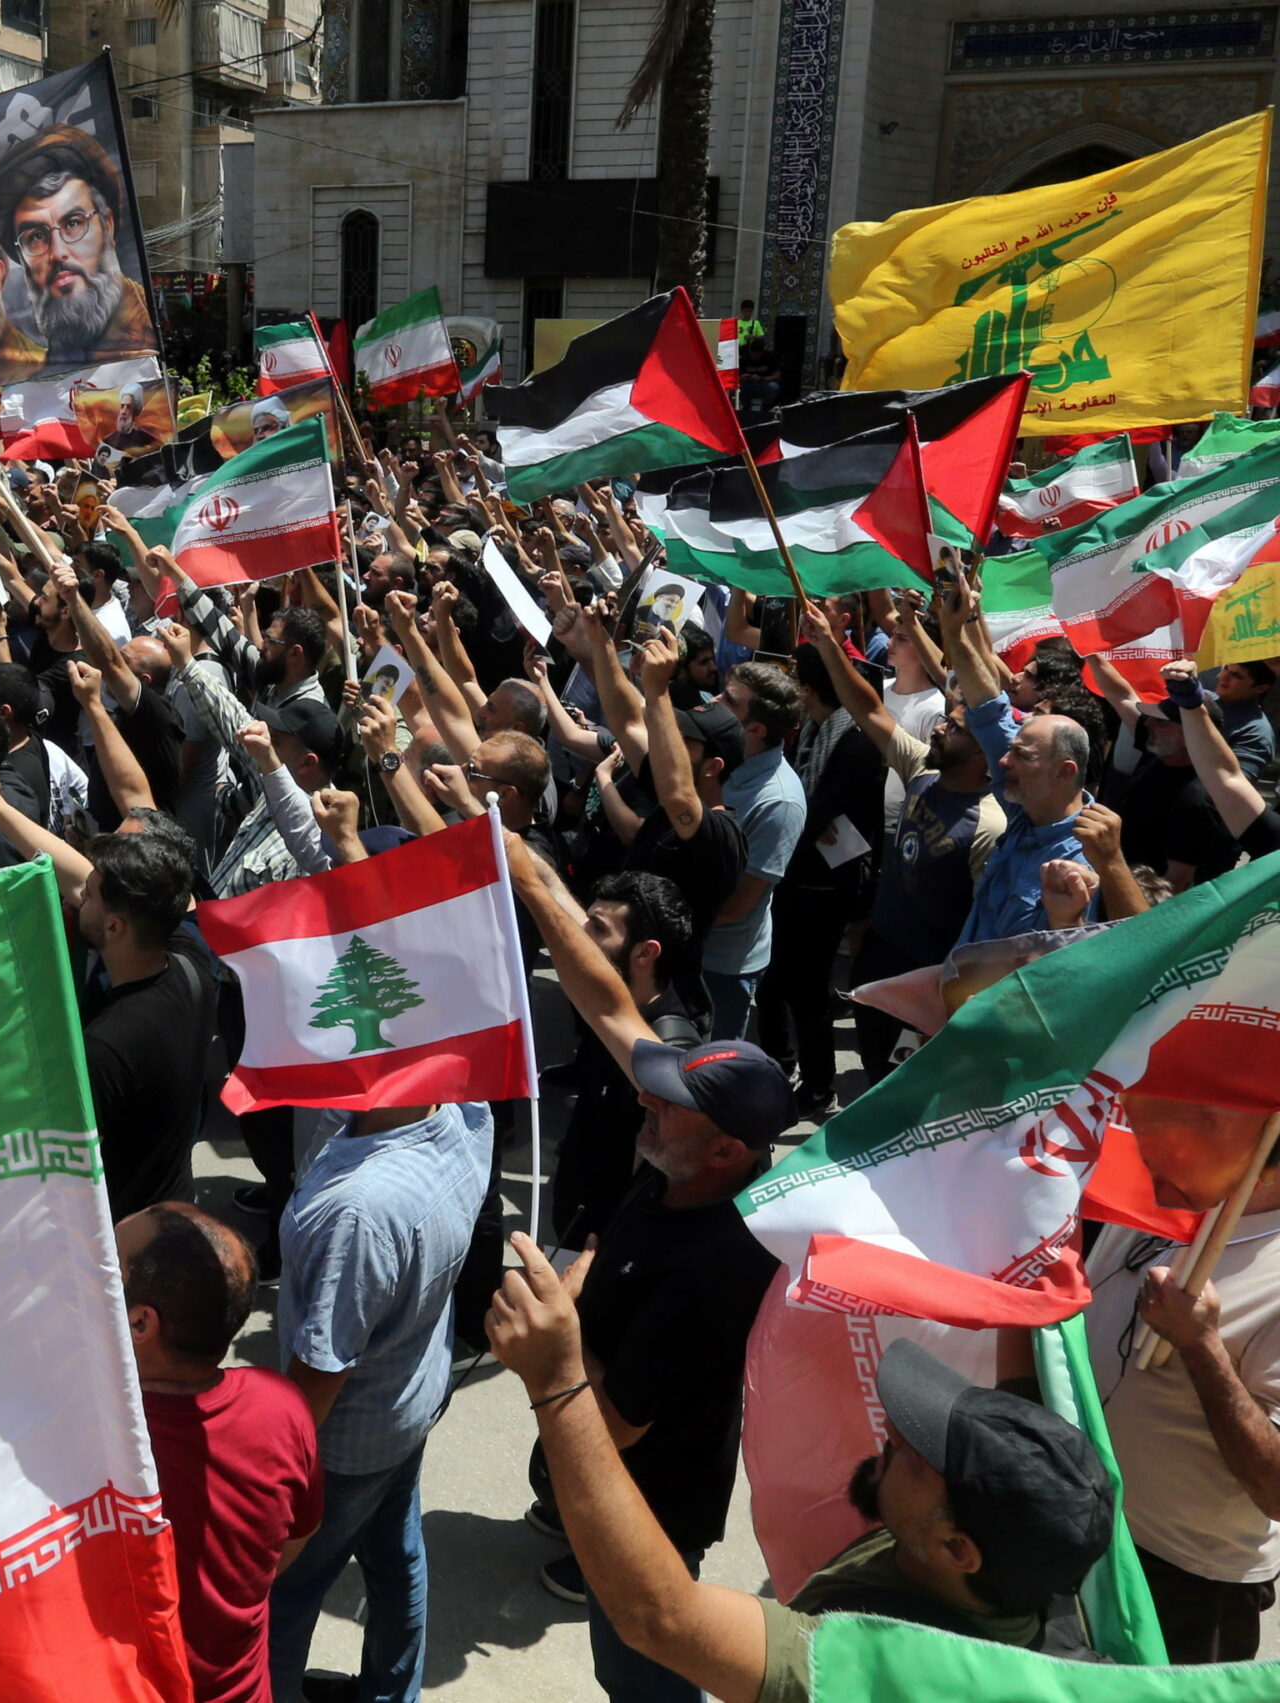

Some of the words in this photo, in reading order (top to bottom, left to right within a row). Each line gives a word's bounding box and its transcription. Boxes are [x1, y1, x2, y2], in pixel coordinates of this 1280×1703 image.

[1096, 192, 1118, 213] فإن
[1060, 211, 1091, 229] حزب
[1035, 223, 1053, 240] الله
[1014, 235, 1030, 252] هم
[961, 241, 1008, 270] الغالبون
[1059, 394, 1116, 412] المقاومة
